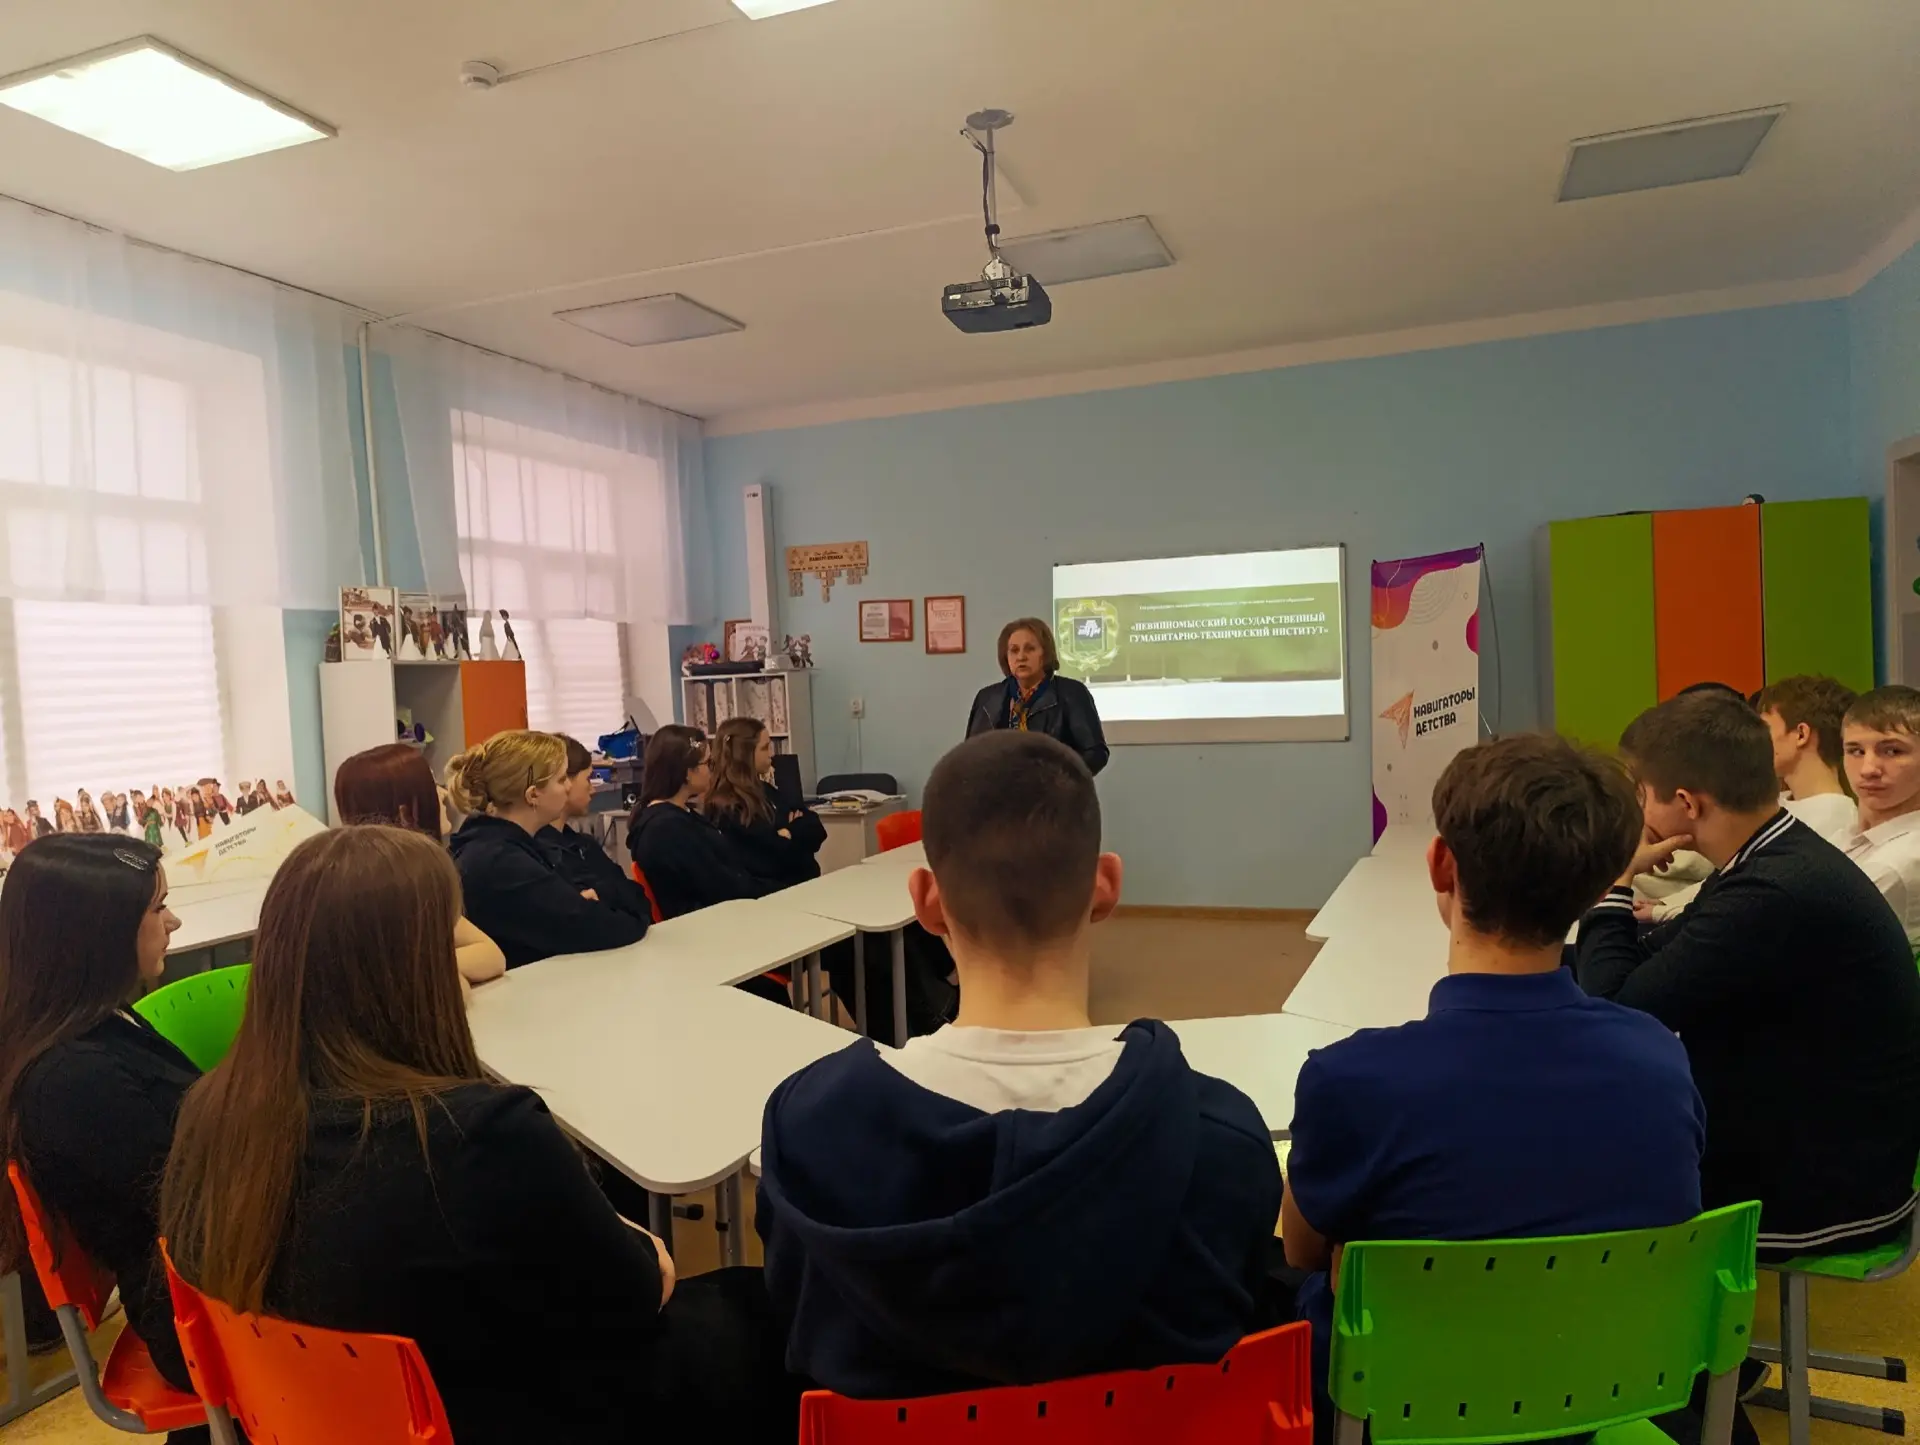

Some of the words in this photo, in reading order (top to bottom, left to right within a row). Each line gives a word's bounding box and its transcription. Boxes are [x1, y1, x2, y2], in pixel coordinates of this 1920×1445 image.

[1229, 612, 1325, 626] ГОСУДАРСТВЕННЫЙ
[1129, 626, 1270, 642] ГУМАНИТАРНО-ТЕХНИЧЕСКИЙ
[1413, 687, 1475, 718] НАВИГАТОРЫ
[1416, 712, 1457, 737] ДЕТСТВА
[218, 838, 247, 856] ДЕТСТВА
